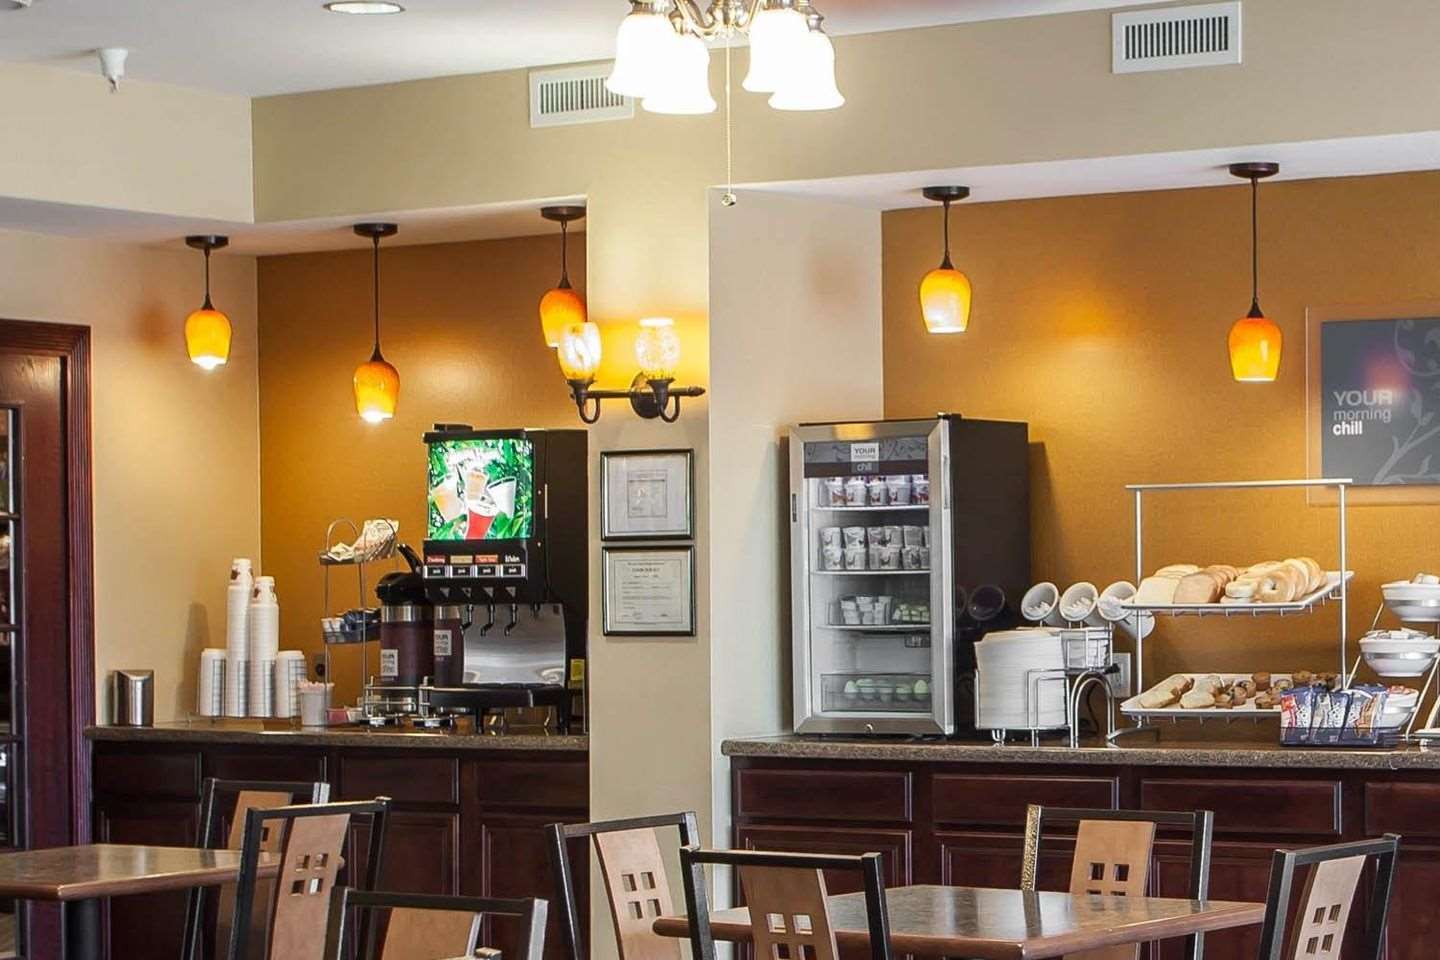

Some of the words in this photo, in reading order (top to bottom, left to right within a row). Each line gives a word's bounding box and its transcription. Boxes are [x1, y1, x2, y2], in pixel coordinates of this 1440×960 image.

[1333, 390, 1393, 406] YOUR
[1333, 408, 1391, 423] morning
[1333, 420, 1363, 435] chill
